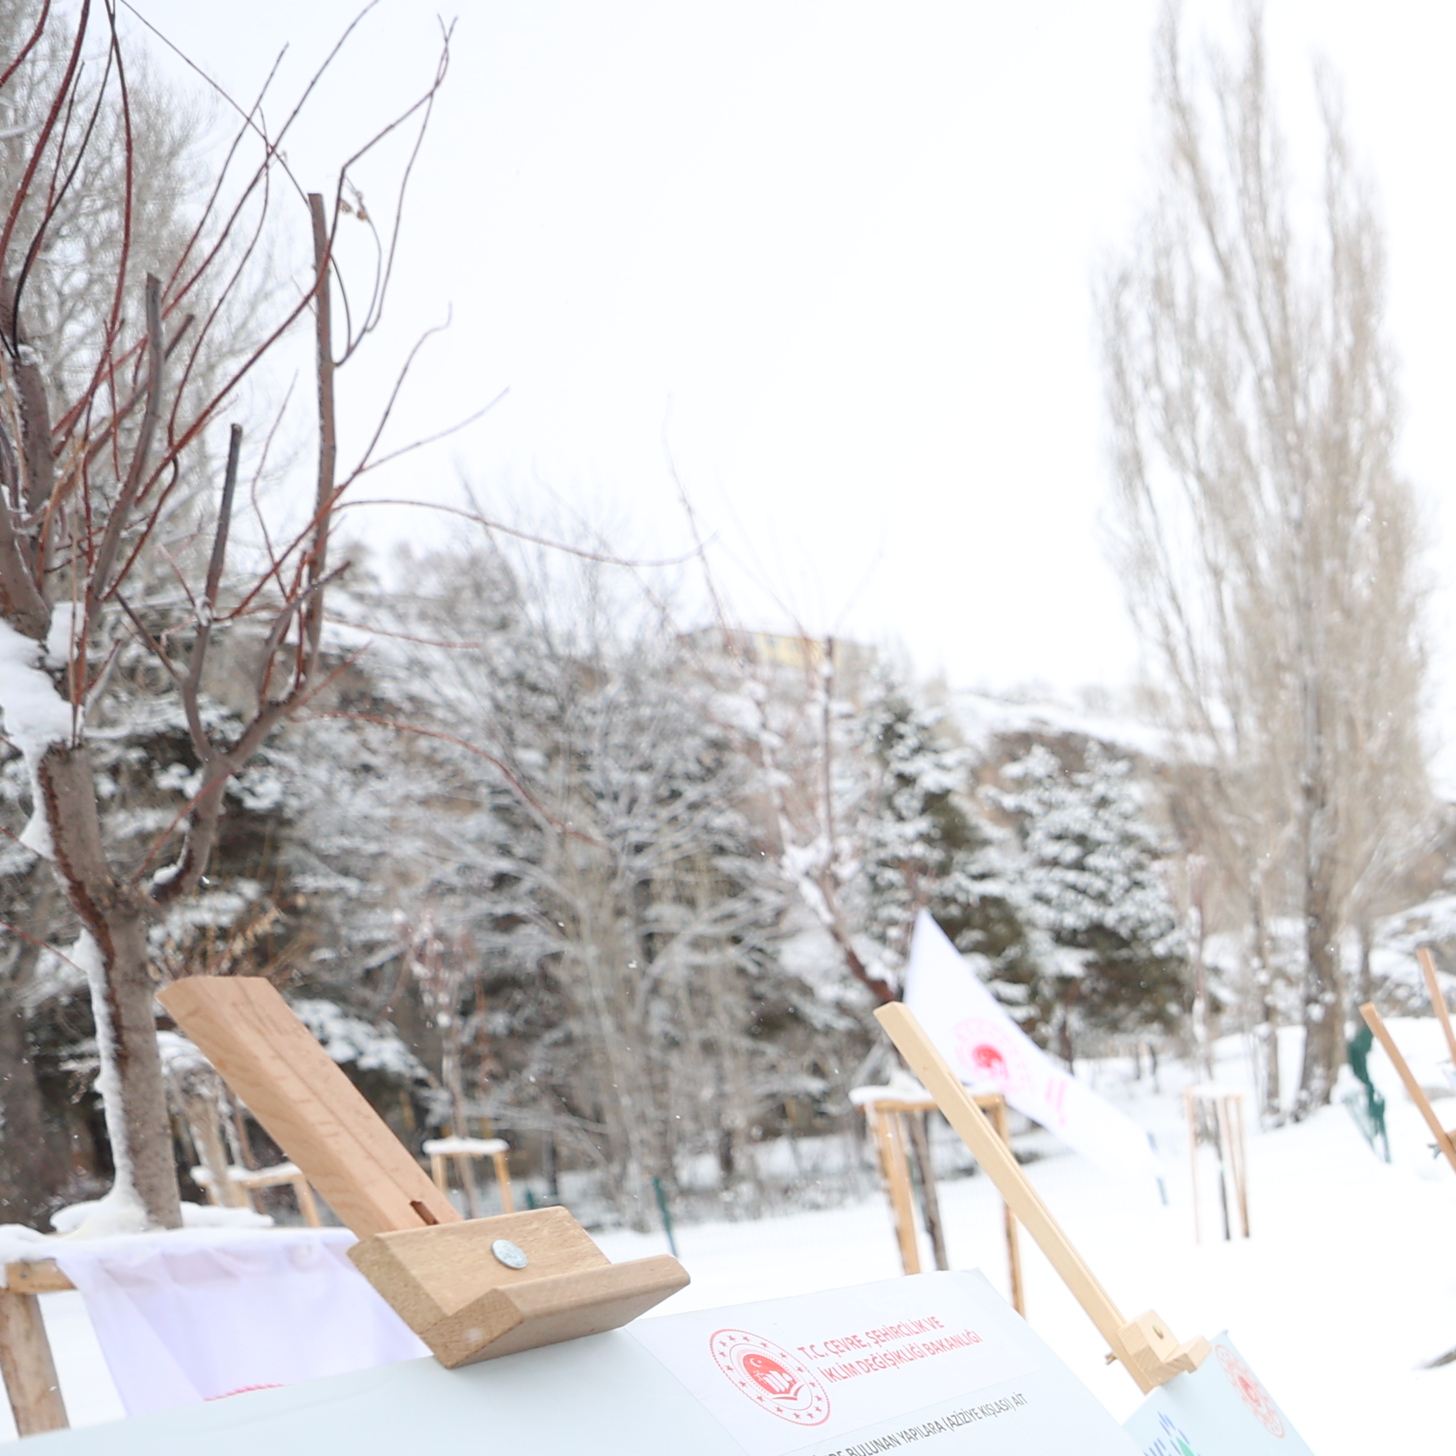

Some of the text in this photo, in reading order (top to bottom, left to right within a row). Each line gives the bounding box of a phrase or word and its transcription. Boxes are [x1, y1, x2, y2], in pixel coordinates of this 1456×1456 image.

[797, 1342, 827, 1361] T.C.
[865, 1316, 927, 1347] ŞEHİRCİLİK
[924, 1315, 945, 1332] VE
[818, 1330, 983, 1384] İKLİM DEĞİŞİKLİĞİ BAKANLIĞI
[898, 1420, 946, 1446] YAPILARA
